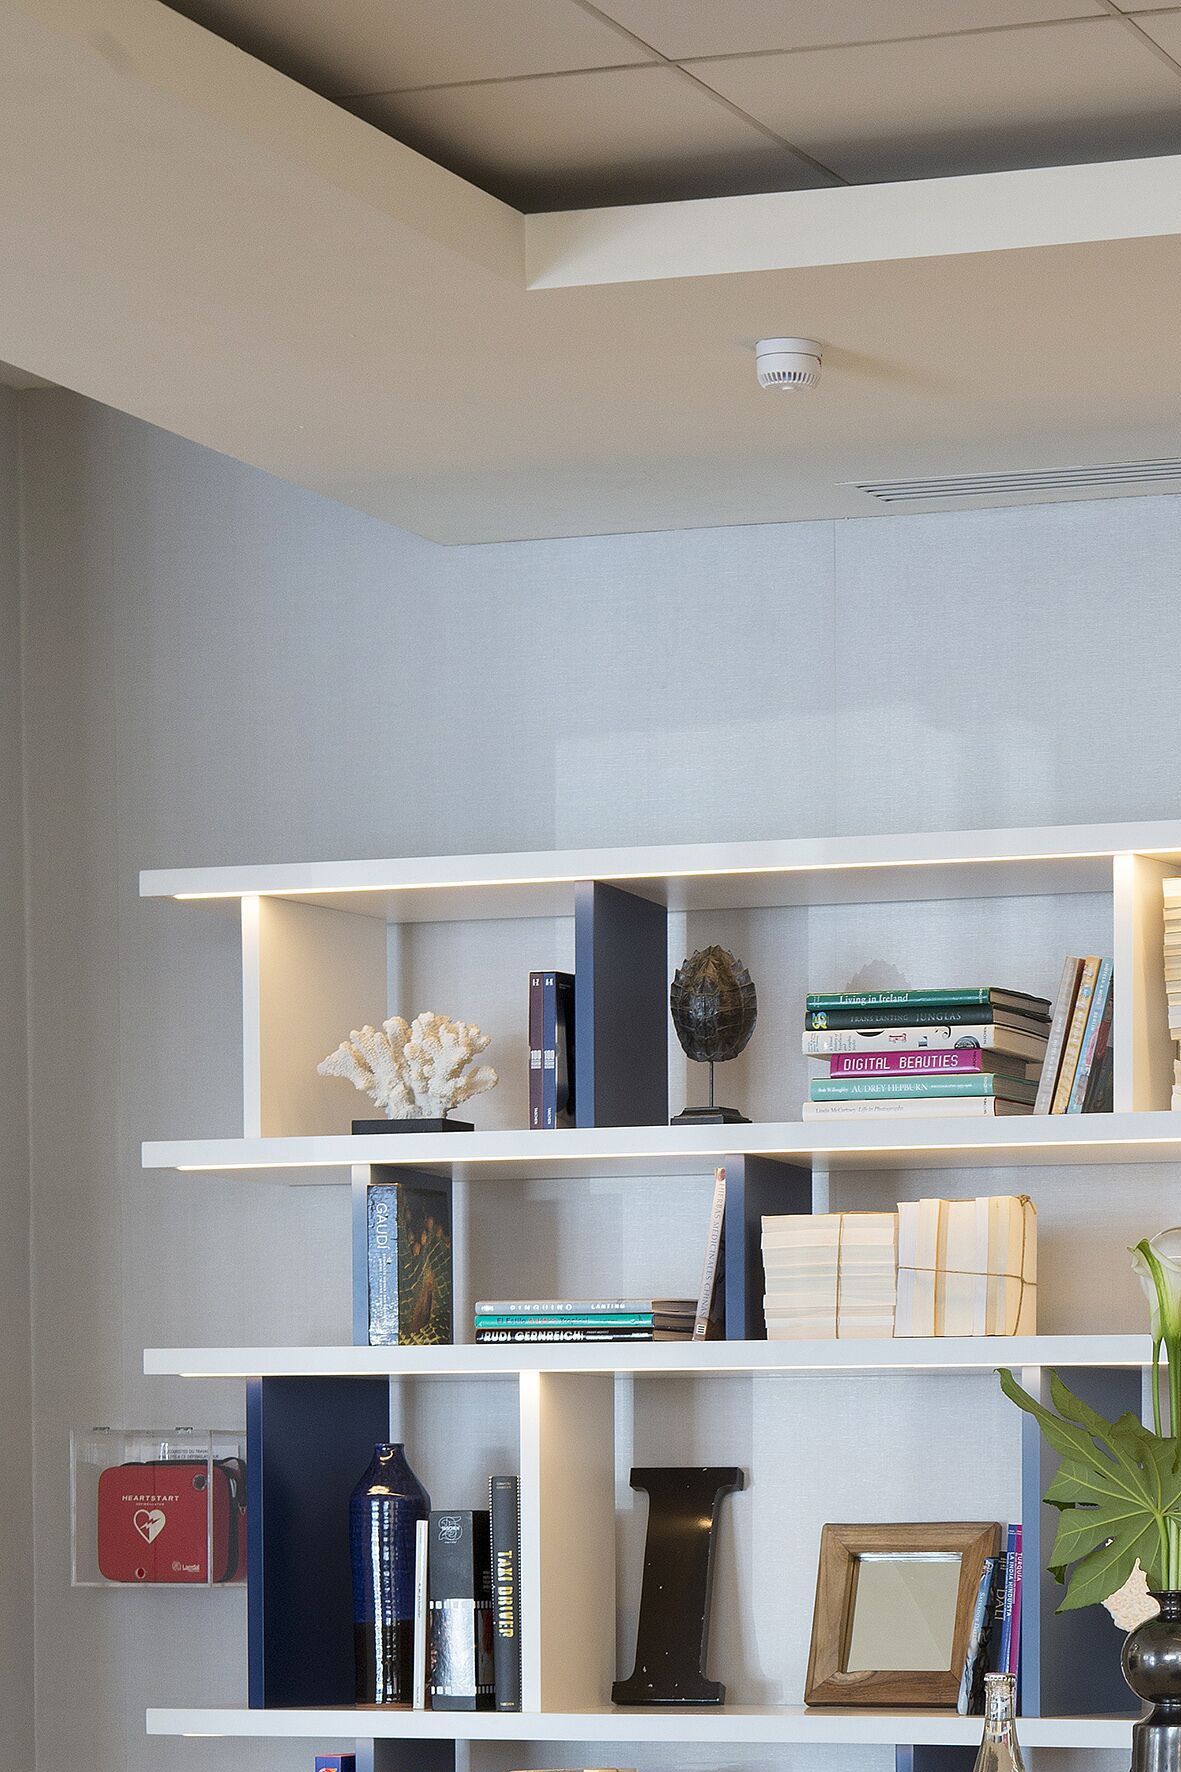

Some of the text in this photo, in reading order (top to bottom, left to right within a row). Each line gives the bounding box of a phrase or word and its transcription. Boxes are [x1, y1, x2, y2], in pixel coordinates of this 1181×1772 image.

[839, 993, 909, 1006] Living in Ireland
[843, 1055, 959, 1071] DIGITAL BEAUTIES
[851, 1084, 885, 1093] AUDREY
[887, 1083, 928, 1092] HEPBURN
[483, 1331, 512, 1341] RUDI
[514, 1330, 584, 1341] GERNREICH
[497, 1550, 514, 1638] TAXI DRIVER
[1006, 1580, 1014, 1617] HINDUISTA
